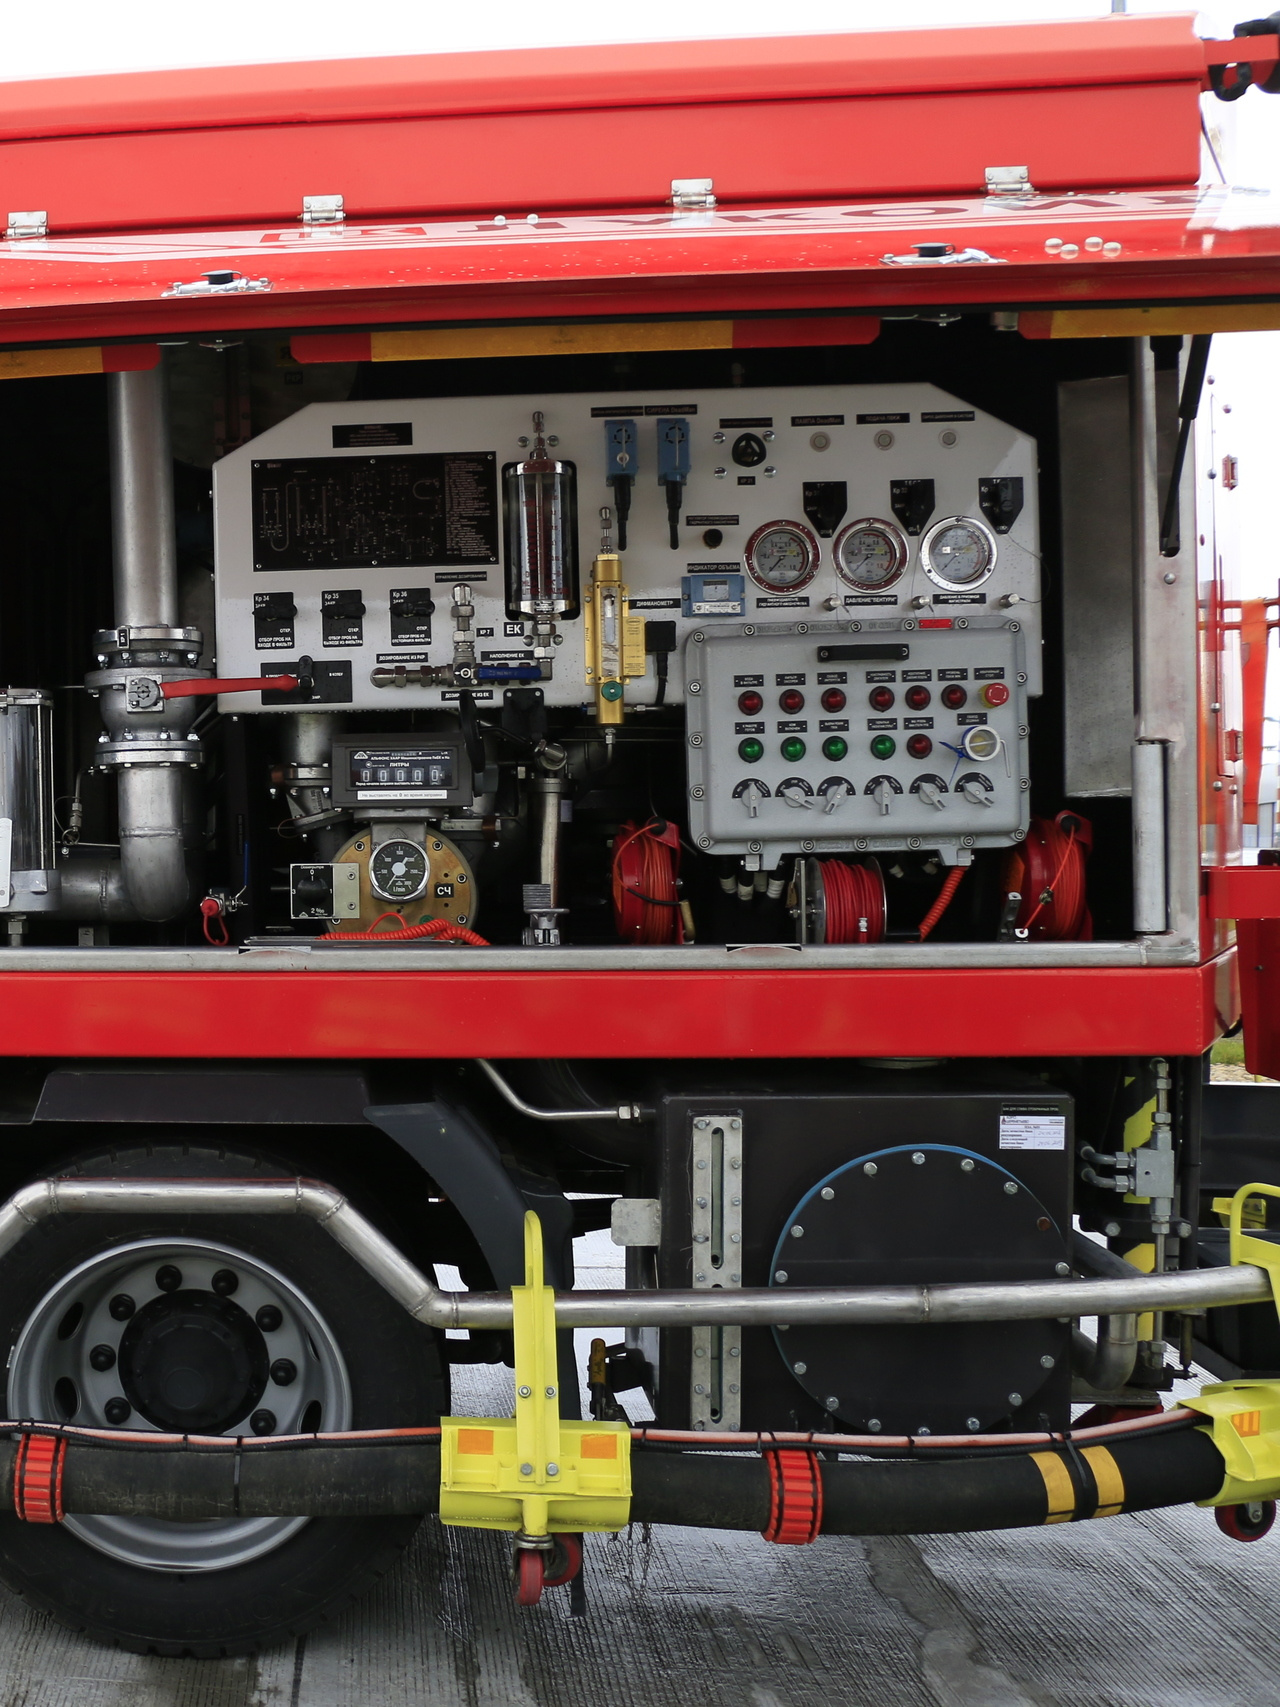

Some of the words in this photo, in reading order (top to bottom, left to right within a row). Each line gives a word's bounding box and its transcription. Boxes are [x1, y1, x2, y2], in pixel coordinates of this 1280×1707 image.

[636, 600, 674, 608] ДИФМАНОМЕТР
[363, 770, 370, 782] 0
[380, 770, 387, 782] 0
[397, 770, 404, 782] 0
[414, 770, 421, 782] 0
[431, 769, 438, 781] 0
[437, 886, 452, 895] СЧ
